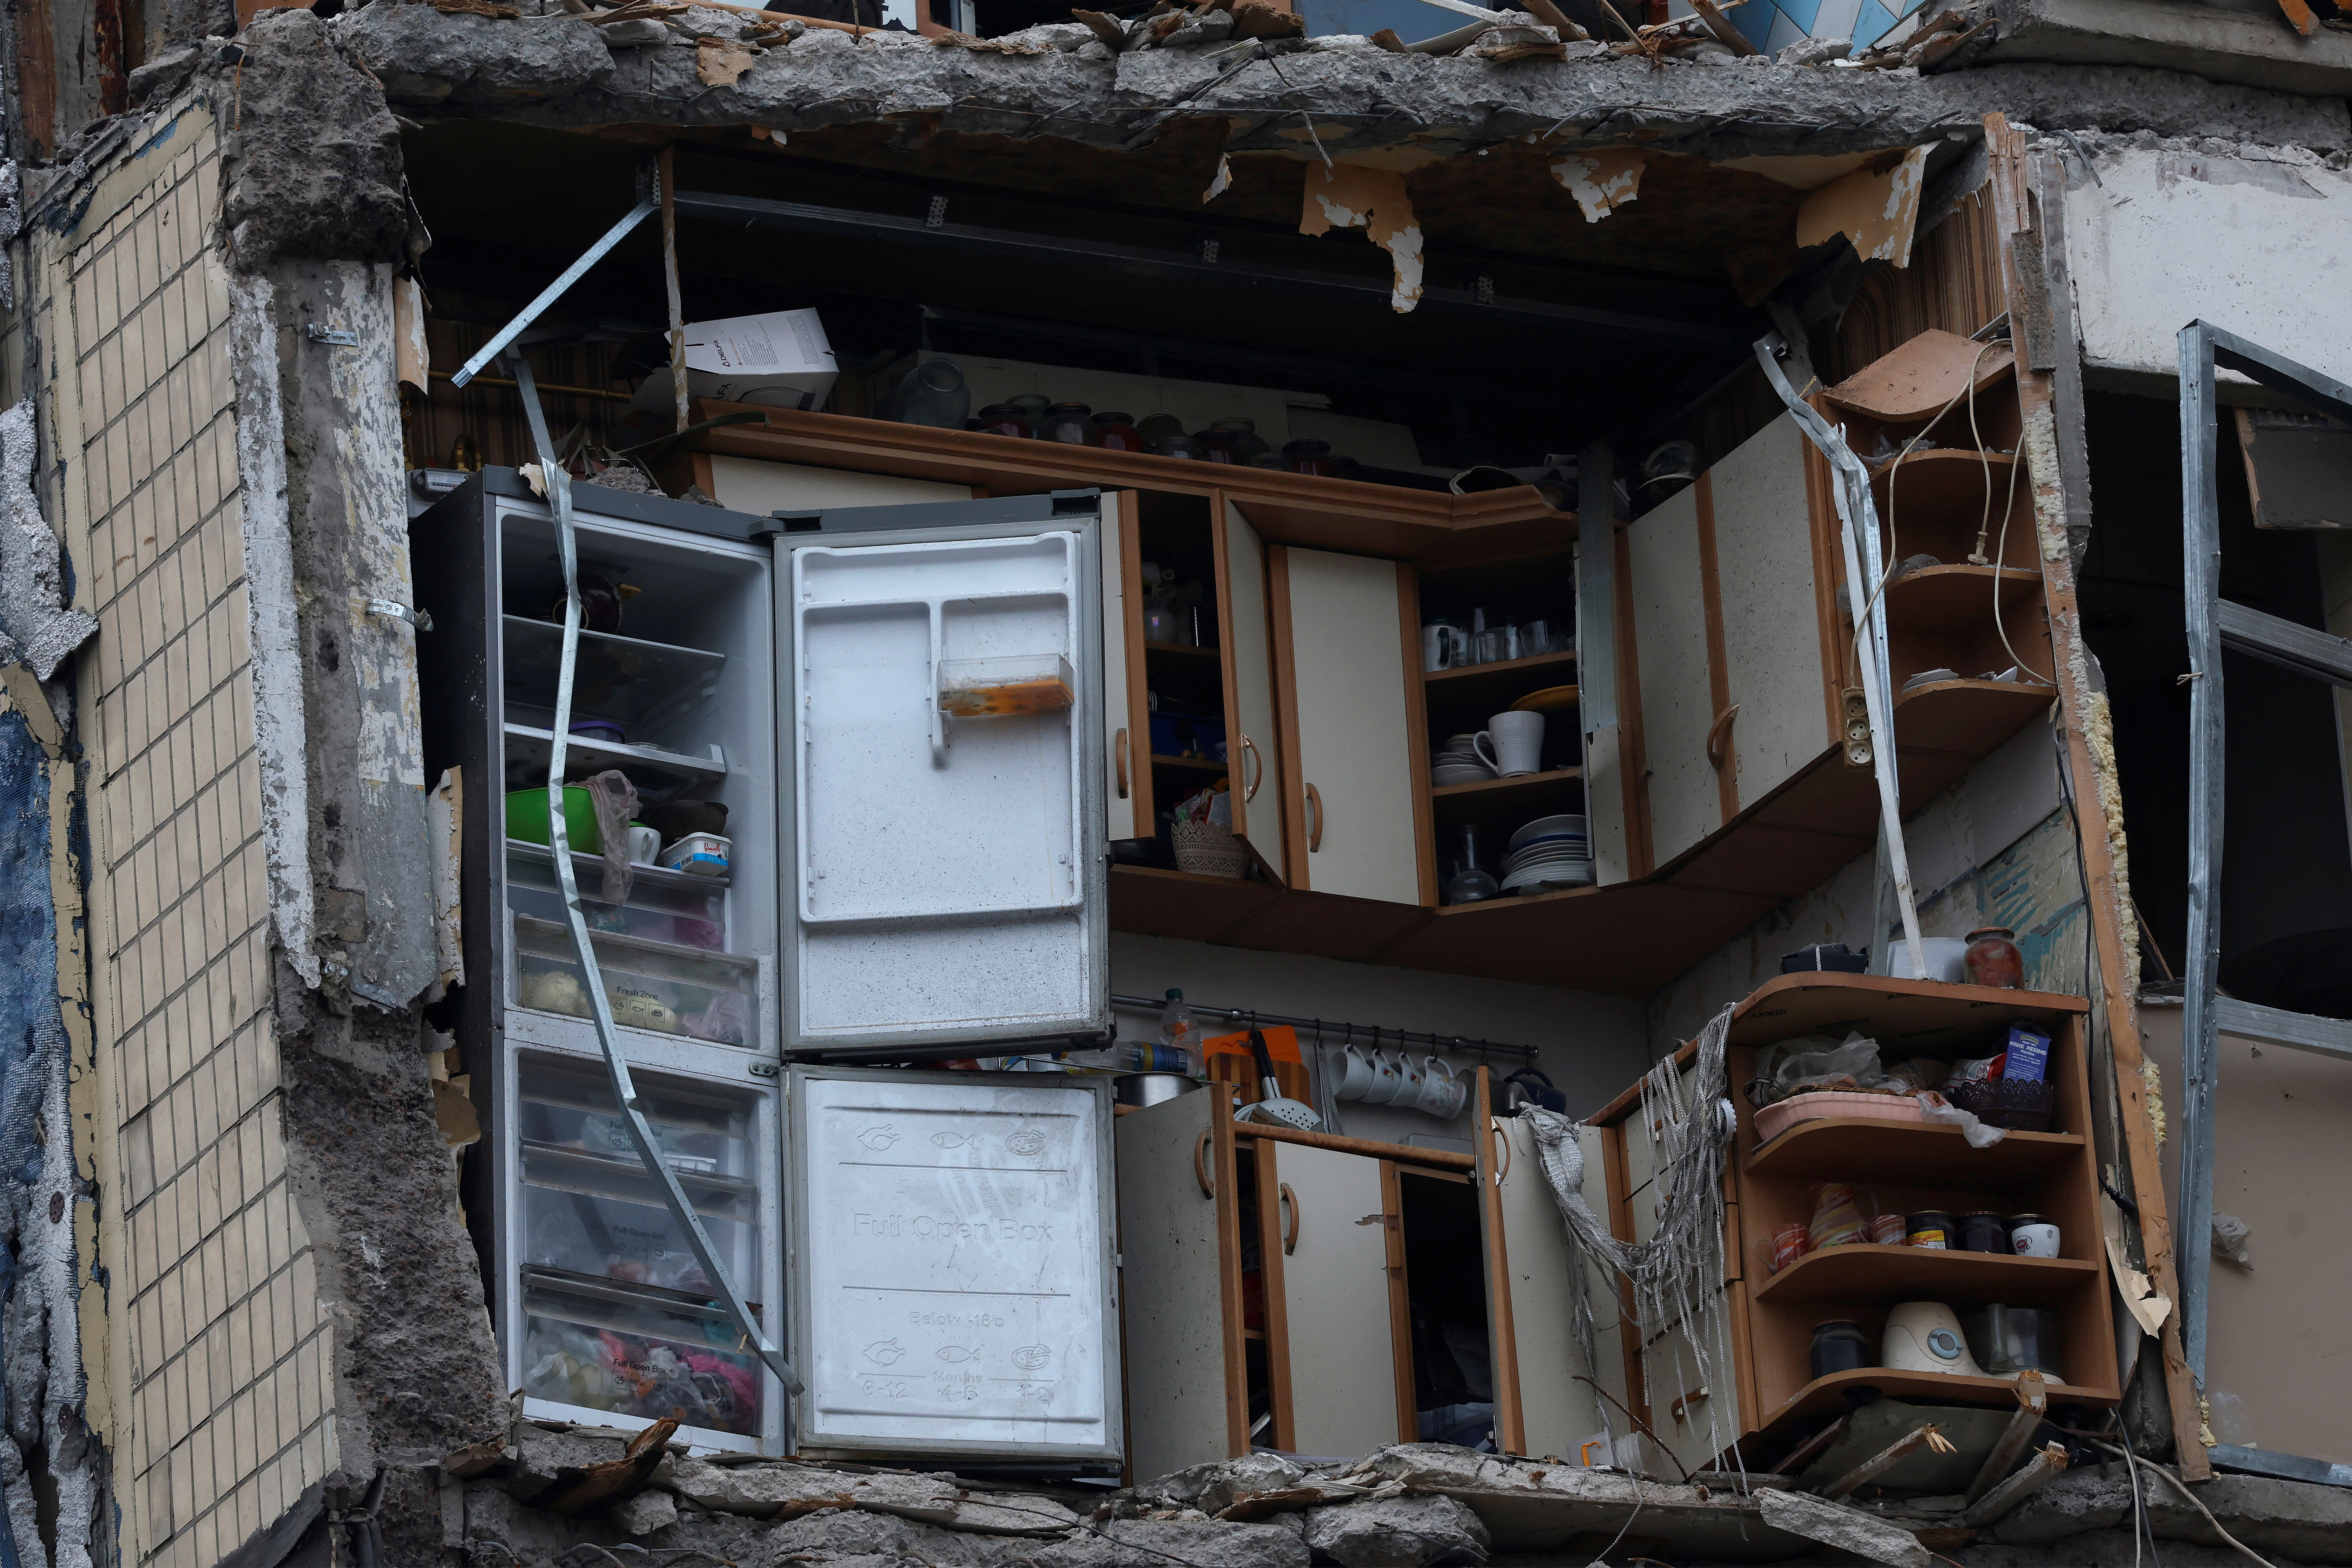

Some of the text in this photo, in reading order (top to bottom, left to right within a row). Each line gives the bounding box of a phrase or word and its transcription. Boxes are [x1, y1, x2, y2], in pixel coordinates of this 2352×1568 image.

[713, 340, 726, 361] DELFA
[713, 383, 732, 399] LFA
[1451, 652, 1465, 660] RIME
[617, 986, 658, 1000] Fresh Zone
[2009, 1041, 2046, 1055] PANE AZZIMO
[614, 1225, 627, 1234] Full
[855, 1213, 1054, 1244] Full Open Box
[909, 1312, 961, 1324] Below
[613, 1359, 666, 1374] Full Open Box
[933, 1372, 983, 1382] Months
[863, 1381, 908, 1398] 6-12
[941, 1385, 977, 1401] 4-6
